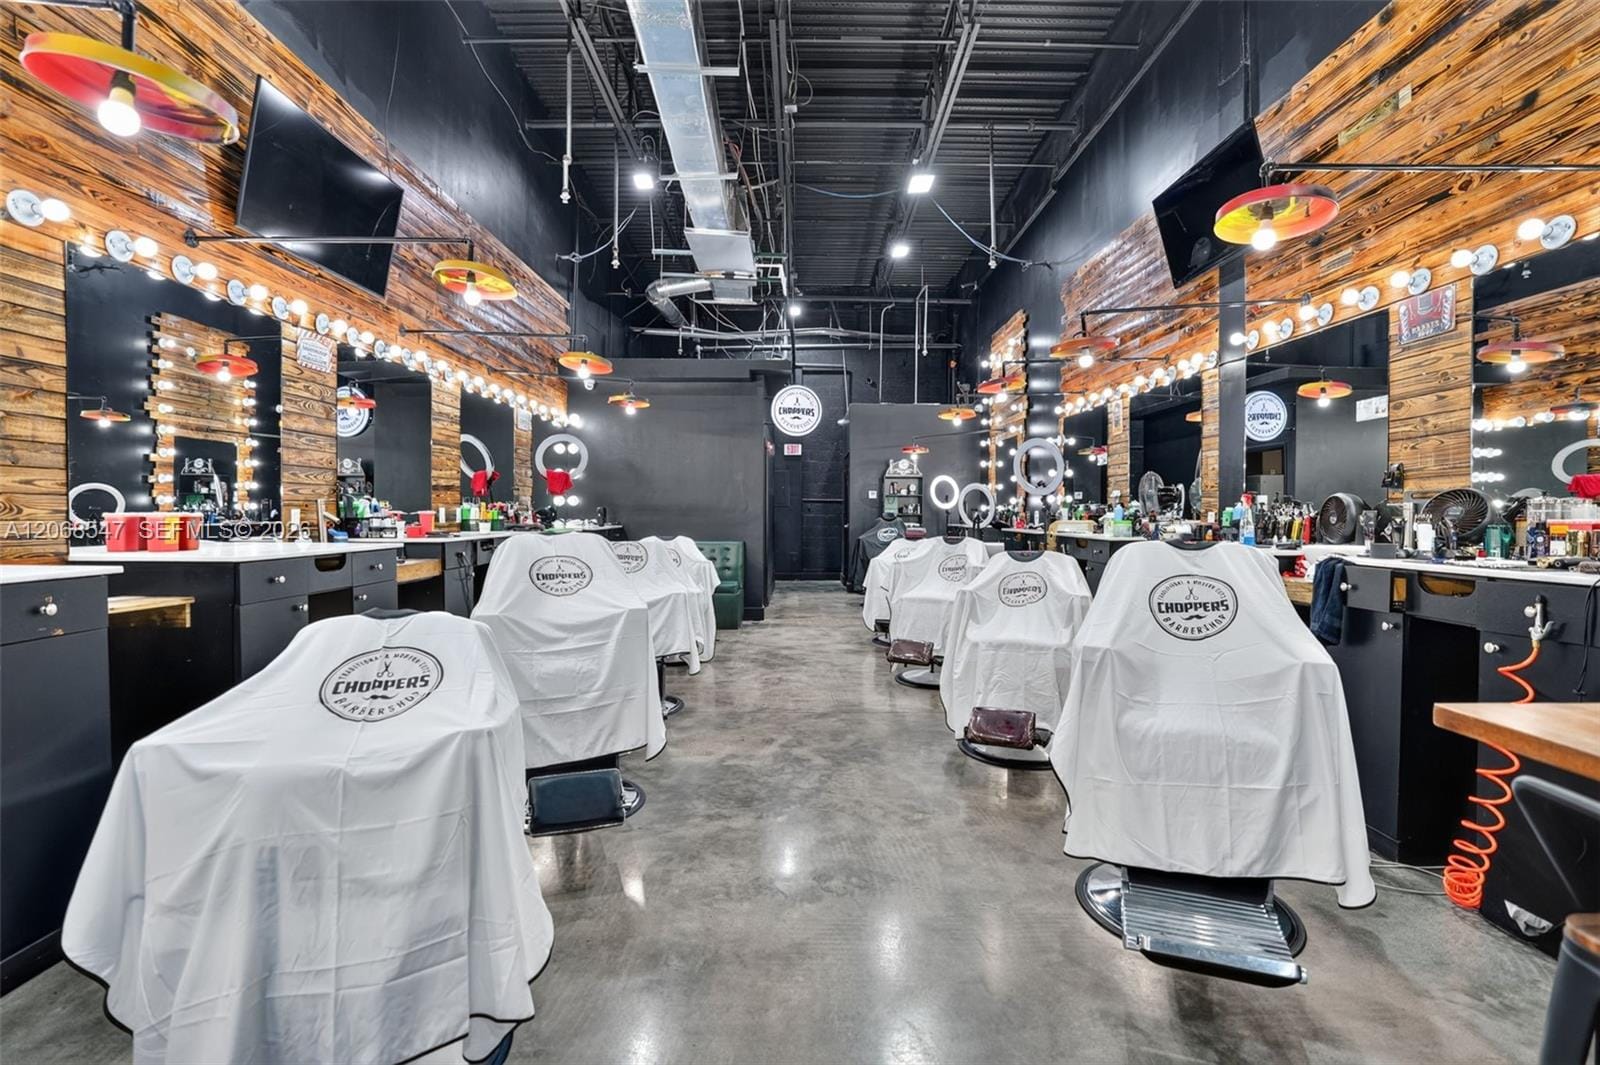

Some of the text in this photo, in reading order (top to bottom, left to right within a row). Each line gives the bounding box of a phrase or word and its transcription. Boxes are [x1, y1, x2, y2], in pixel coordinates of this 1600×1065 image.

[778, 406, 815, 417] CHOPPERS
[1157, 599, 1230, 614] CHOPPERS
[1162, 614, 1227, 635] BARBERSHOP
[331, 674, 431, 695] CHOPPERS
